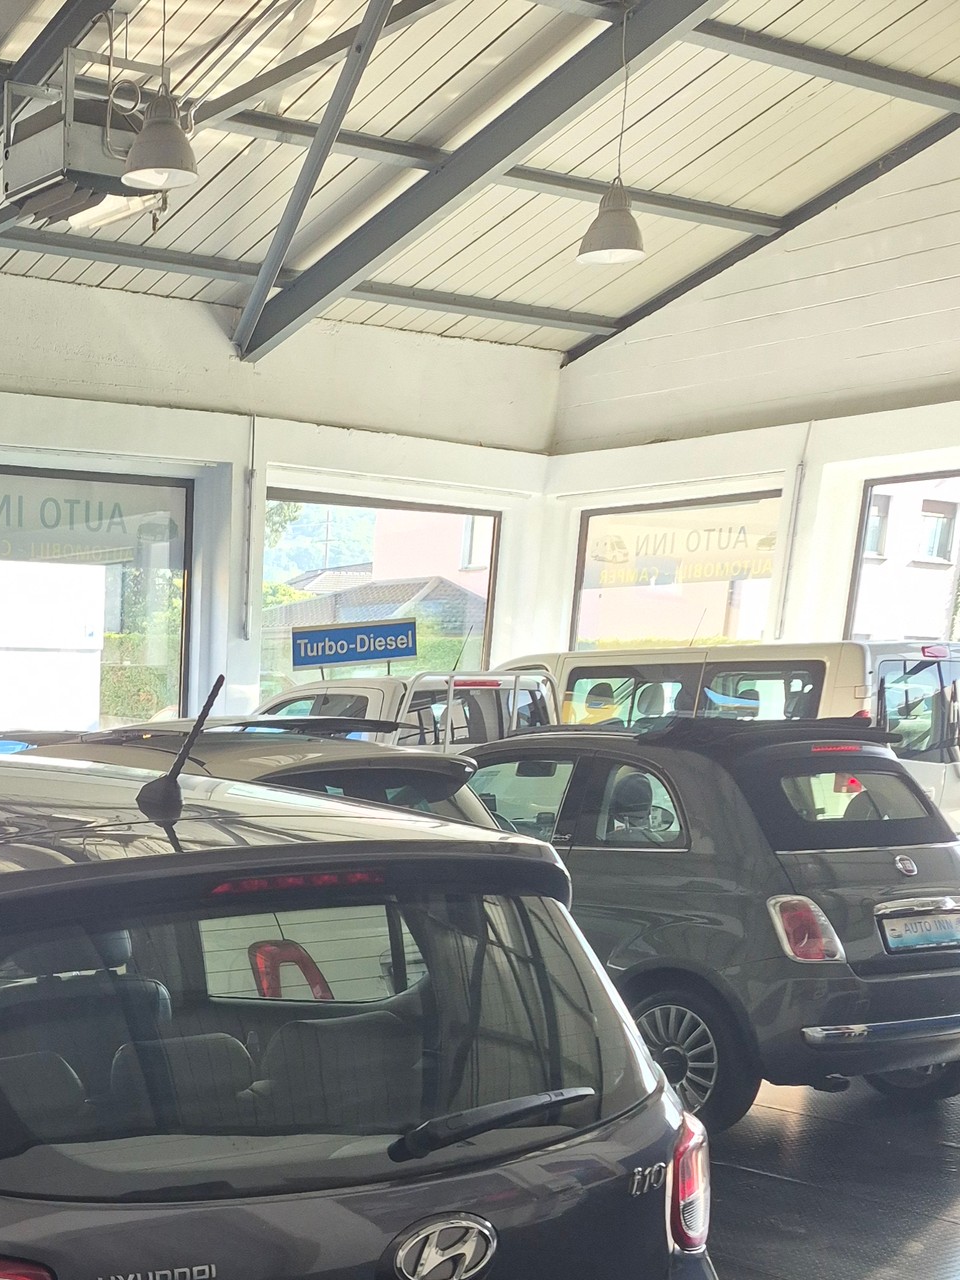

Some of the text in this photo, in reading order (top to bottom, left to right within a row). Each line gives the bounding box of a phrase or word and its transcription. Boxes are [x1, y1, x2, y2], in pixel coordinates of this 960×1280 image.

[297, 630, 413, 657] Turbo-Diesel
[904, 918, 954, 934] AUTO INN
[629, 1162, 667, 1197] i10
